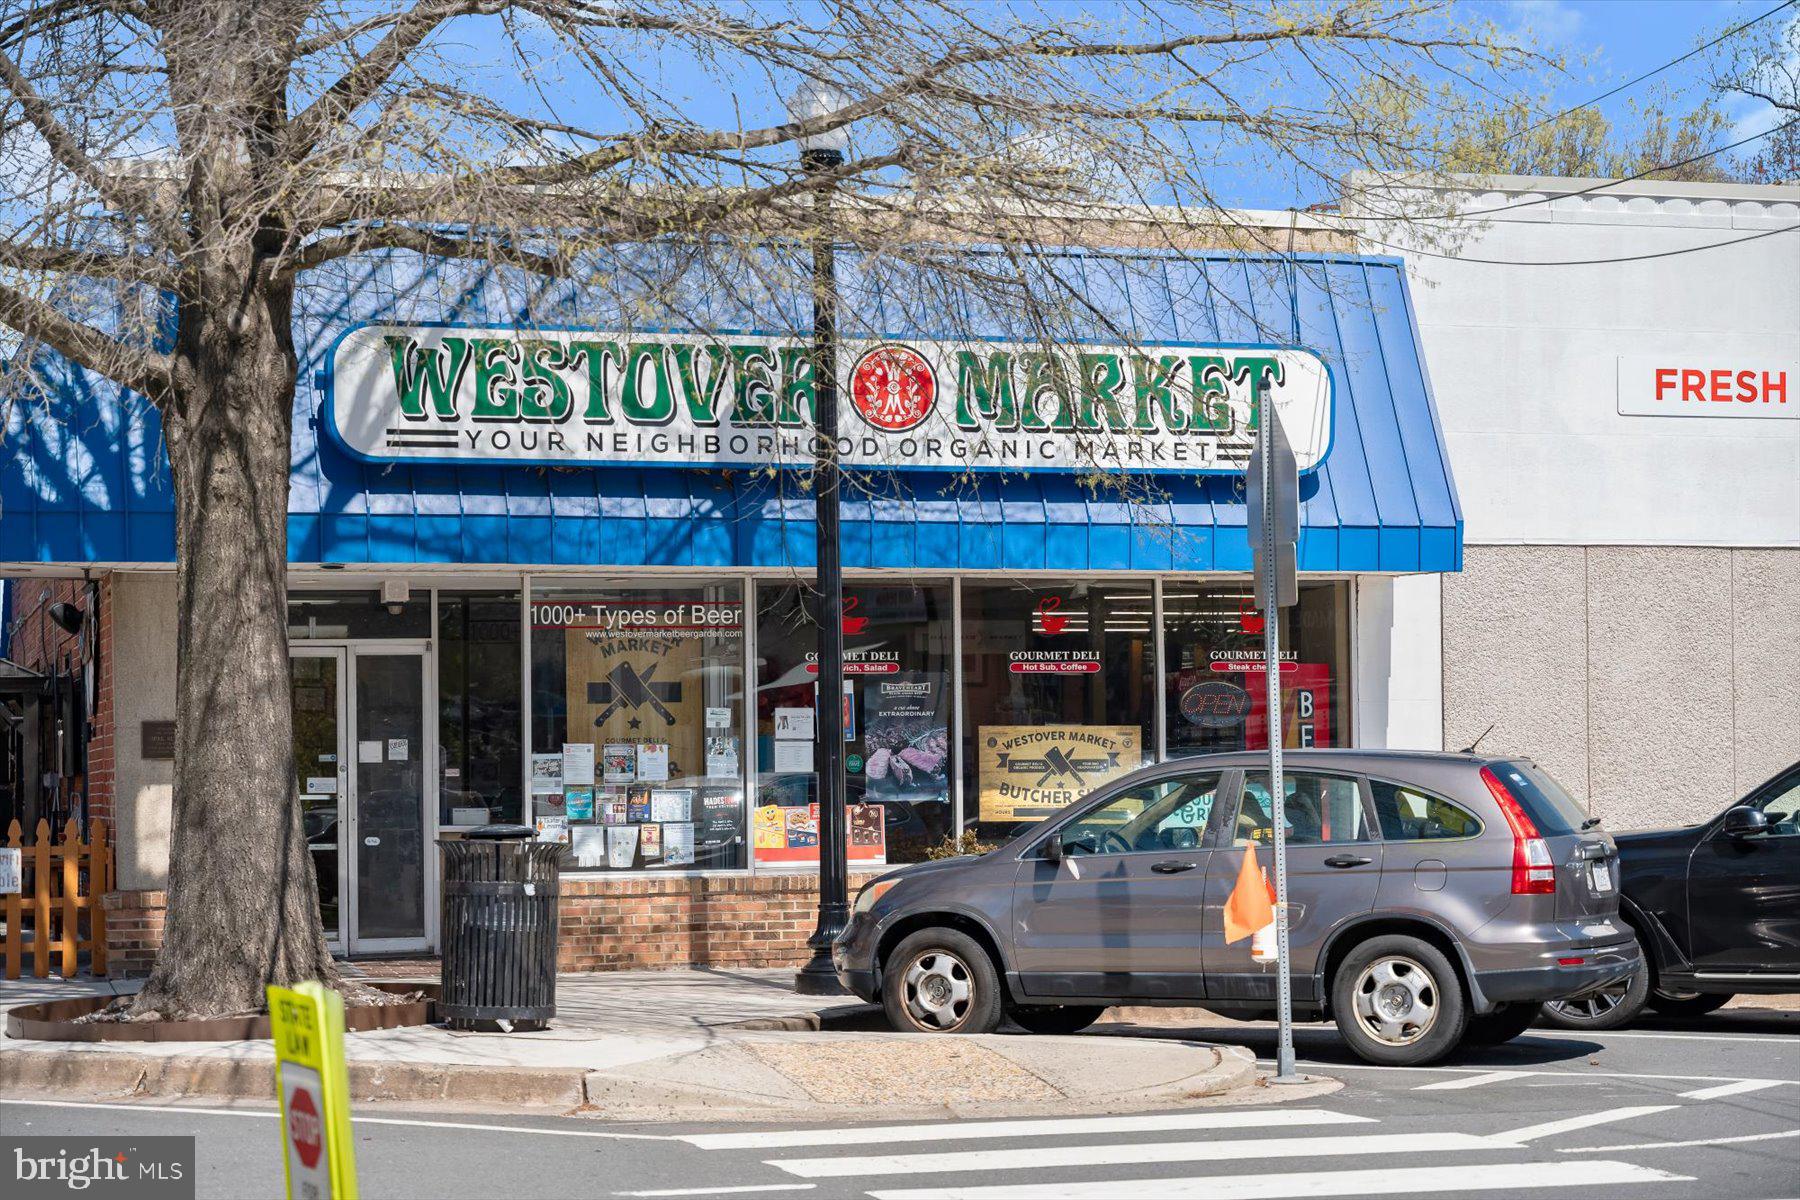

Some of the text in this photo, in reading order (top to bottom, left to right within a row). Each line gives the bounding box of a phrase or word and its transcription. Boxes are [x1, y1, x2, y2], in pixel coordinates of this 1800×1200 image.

[384, 335, 1286, 434] WESTOVER MARKET
[1655, 368, 1787, 404] FRESH
[464, 429, 564, 452] YOUR
[900, 438, 1056, 460] ORGANIC
[1075, 440, 1210, 462] MARKET
[531, 605, 742, 629] 1000+ Types of Beer
[585, 630, 743, 640] www.westovermarketbeergarden.com
[600, 638, 673, 658] MARKET
[870, 651, 899, 661] DELI
[1010, 651, 1099, 661] GOURMET DELI
[1210, 650, 1267, 660] GOURMET
[863, 664, 888, 672] Salad
[1022, 663, 1038, 671] Hot
[1060, 663, 1087, 671] Coffee
[1228, 663, 1250, 671] Steak
[1184, 693, 1247, 715] OPEN
[1002, 731, 1117, 750] WESTOVER MARKET
[999, 781, 1072, 804] BUTCHER
[291, 1110, 321, 1145] STOP
